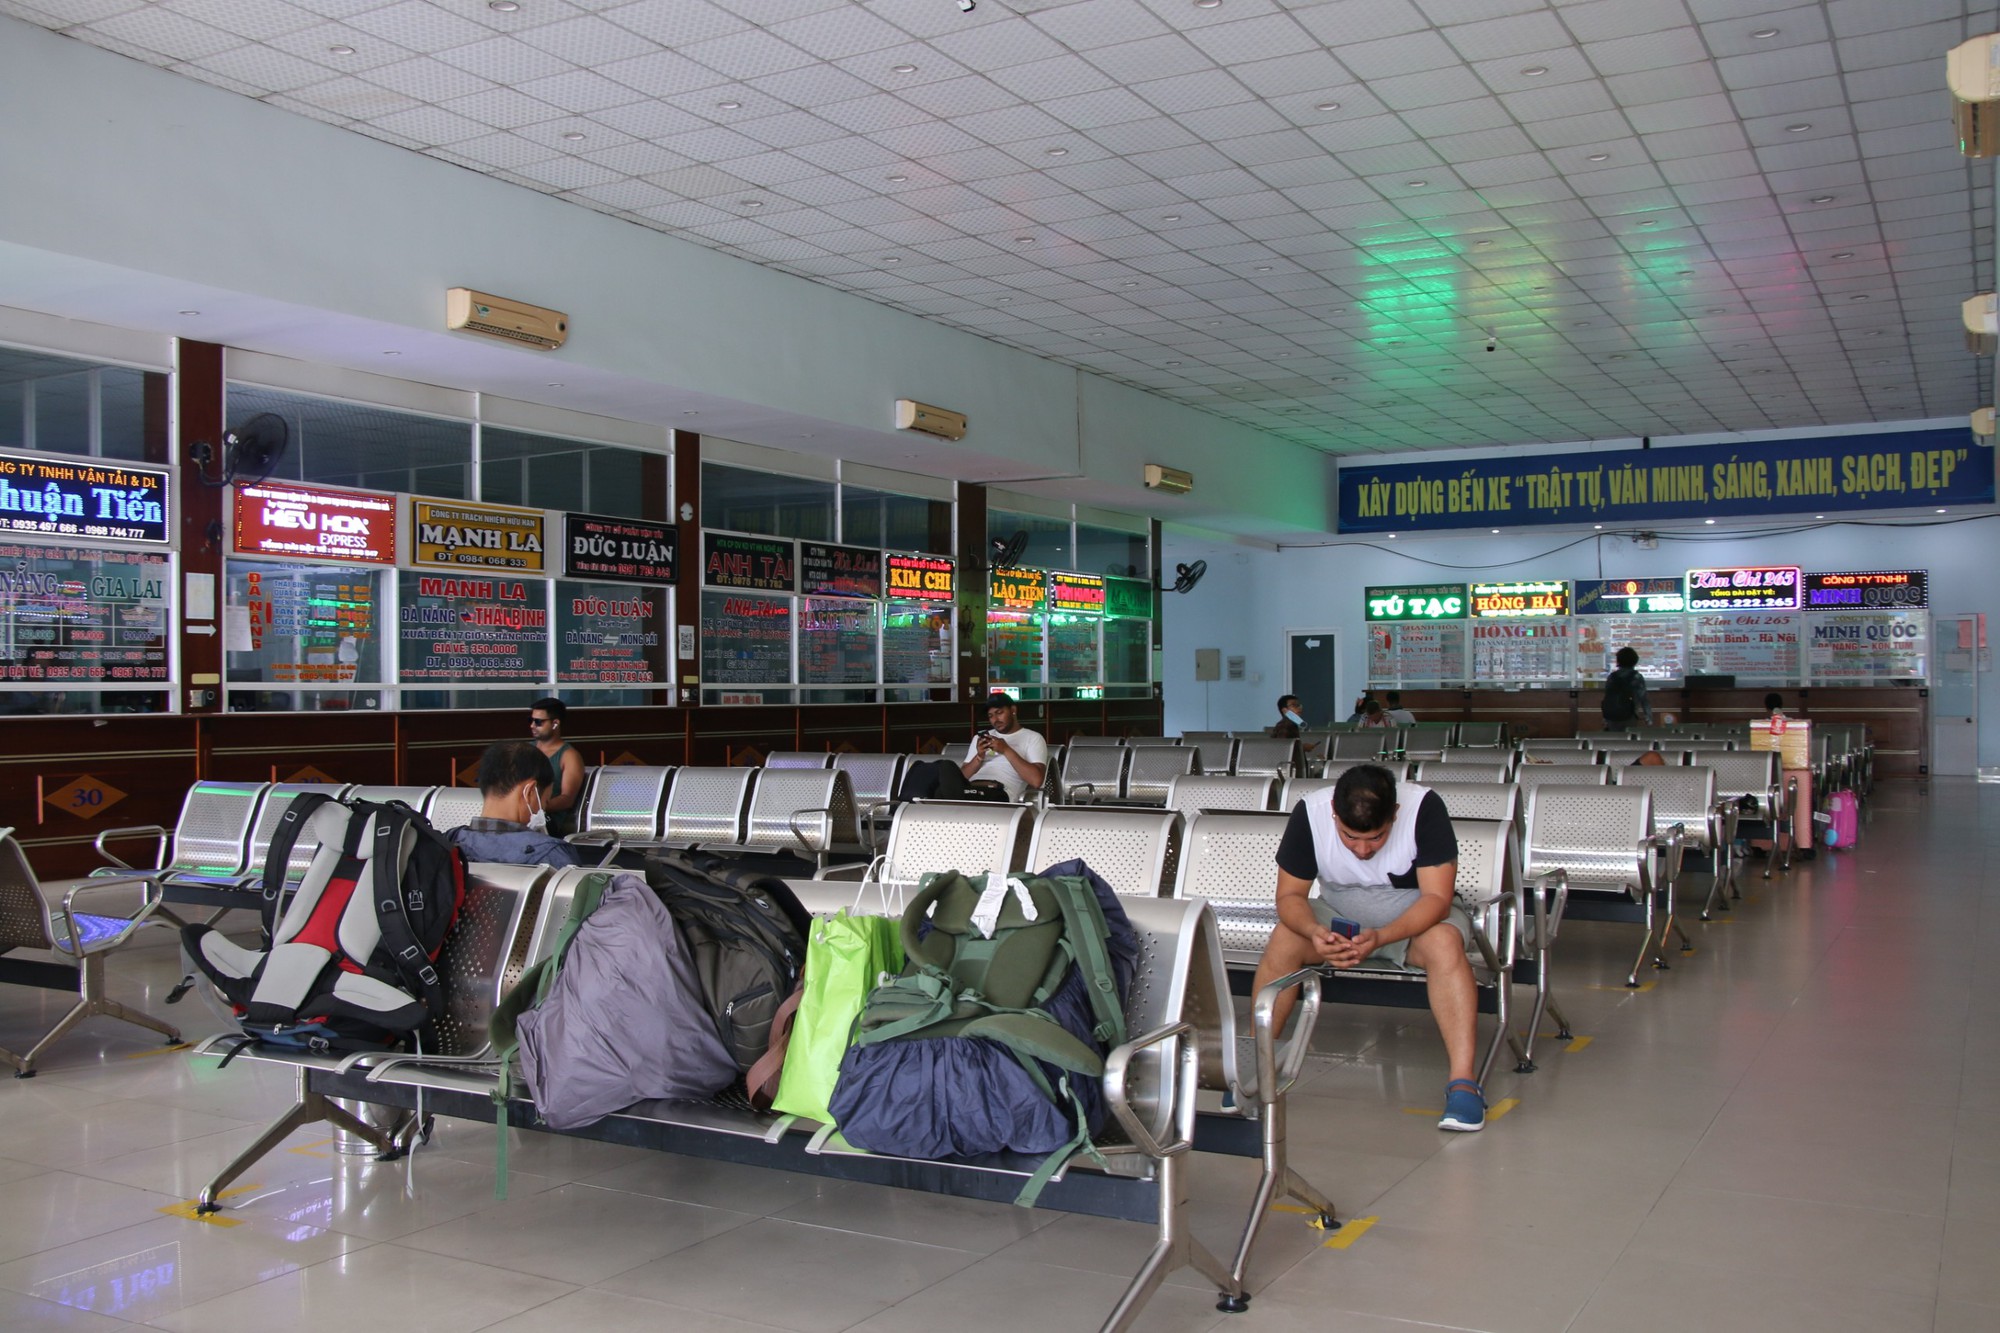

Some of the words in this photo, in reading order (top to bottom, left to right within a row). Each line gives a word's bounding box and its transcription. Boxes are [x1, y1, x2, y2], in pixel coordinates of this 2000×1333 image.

[19, 463, 35, 476] TY
[38, 466, 74, 480] TNHH
[77, 468, 105, 485] VẬN
[107, 469, 127, 486] TẢI
[130, 476, 140, 487] &
[142, 477, 158, 489] DL
[1358, 476, 1391, 518] XÂY
[1395, 475, 1444, 521] DỰNG
[1448, 468, 1485, 513] BẾN
[1488, 476, 1511, 511] XE
[1608, 463, 1648, 505] VĂN
[1652, 464, 1709, 504] MINH,
[1712, 455, 1772, 501] SÁNG,
[1776, 457, 1838, 498] XANH,
[1842, 453, 1906, 499] SẠCH,
[91, 488, 163, 523] Tiến
[452, 511, 460, 519] TY
[319, 532, 368, 549] EXPRESS
[421, 523, 502, 550] MẠNH
[509, 531, 543, 553] LA
[574, 534, 616, 557] ĐỨC
[621, 539, 674, 565] LUẬN
[438, 552, 453, 561] ĐT
[459, 554, 483, 564] 0984
[488, 556, 506, 565] 068
[509, 558, 527, 567] 333
[707, 552, 752, 577] ANH
[760, 553, 793, 581] TÀI
[91, 576, 128, 598] GIA
[132, 578, 163, 599] LAI
[420, 577, 492, 601] MẠNH
[499, 581, 527, 601] LA
[890, 568, 921, 588] KIM
[924, 571, 951, 591] CHI
[1691, 572, 1730, 588] Kim
[1732, 571, 1762, 587] Chi
[1763, 571, 1795, 586] 265
[1822, 575, 1855, 585] CÔNG
[1857, 575, 1873, 584] TY
[1874, 574, 1908, 583] TNHH
[993, 578, 1017, 599] LÀO
[1018, 579, 1044, 601] TIẾN
[1810, 588, 1862, 604] MINH
[1864, 583, 1921, 606] QUỐC
[572, 595, 607, 616] ĐỨC
[610, 597, 653, 621] LUẬN
[723, 597, 752, 617] ANH
[1369, 595, 1405, 616] TÚ
[1408, 597, 1461, 618] TẠC
[1477, 592, 1525, 610] HỒNG
[1531, 591, 1563, 609] HẢI
[1691, 597, 1794, 609] 0905.222.265
[401, 604, 419, 624] ĐÀ
[475, 604, 508, 626] THÁI
[511, 604, 546, 627] BÌNH
[1698, 616, 1731, 626] Kim
[1736, 616, 1761, 626] Chi
[1763, 616, 1791, 625] 265
[402, 627, 430, 640] XUẤT
[431, 627, 451, 640] BẾN
[452, 630, 464, 641] 17
[523, 630, 549, 642] NGÀY
[566, 629, 578, 644] ĐÀ
[1695, 634, 1721, 643] Ninh
[1759, 633, 1774, 642] Hà
[1777, 633, 1797, 643] Nội
[1814, 626, 1861, 639] MINH
[1866, 621, 1917, 640] QUỐC
[433, 642, 451, 654] GIÁ
[452, 641, 469, 654] VÉ:
[471, 643, 518, 655] 350.000đ
[1871, 642, 1890, 650] KON
[1894, 641, 1914, 650] TUM
[47, 667, 70, 678] 0935
[71, 667, 87, 678] 497
[89, 667, 105, 678] 666
[150, 667, 167, 678] 777
[600, 671, 620, 682] 0981
[621, 671, 637, 682] 789
[638, 672, 654, 682] 443
[71, 787, 104, 808] 30
